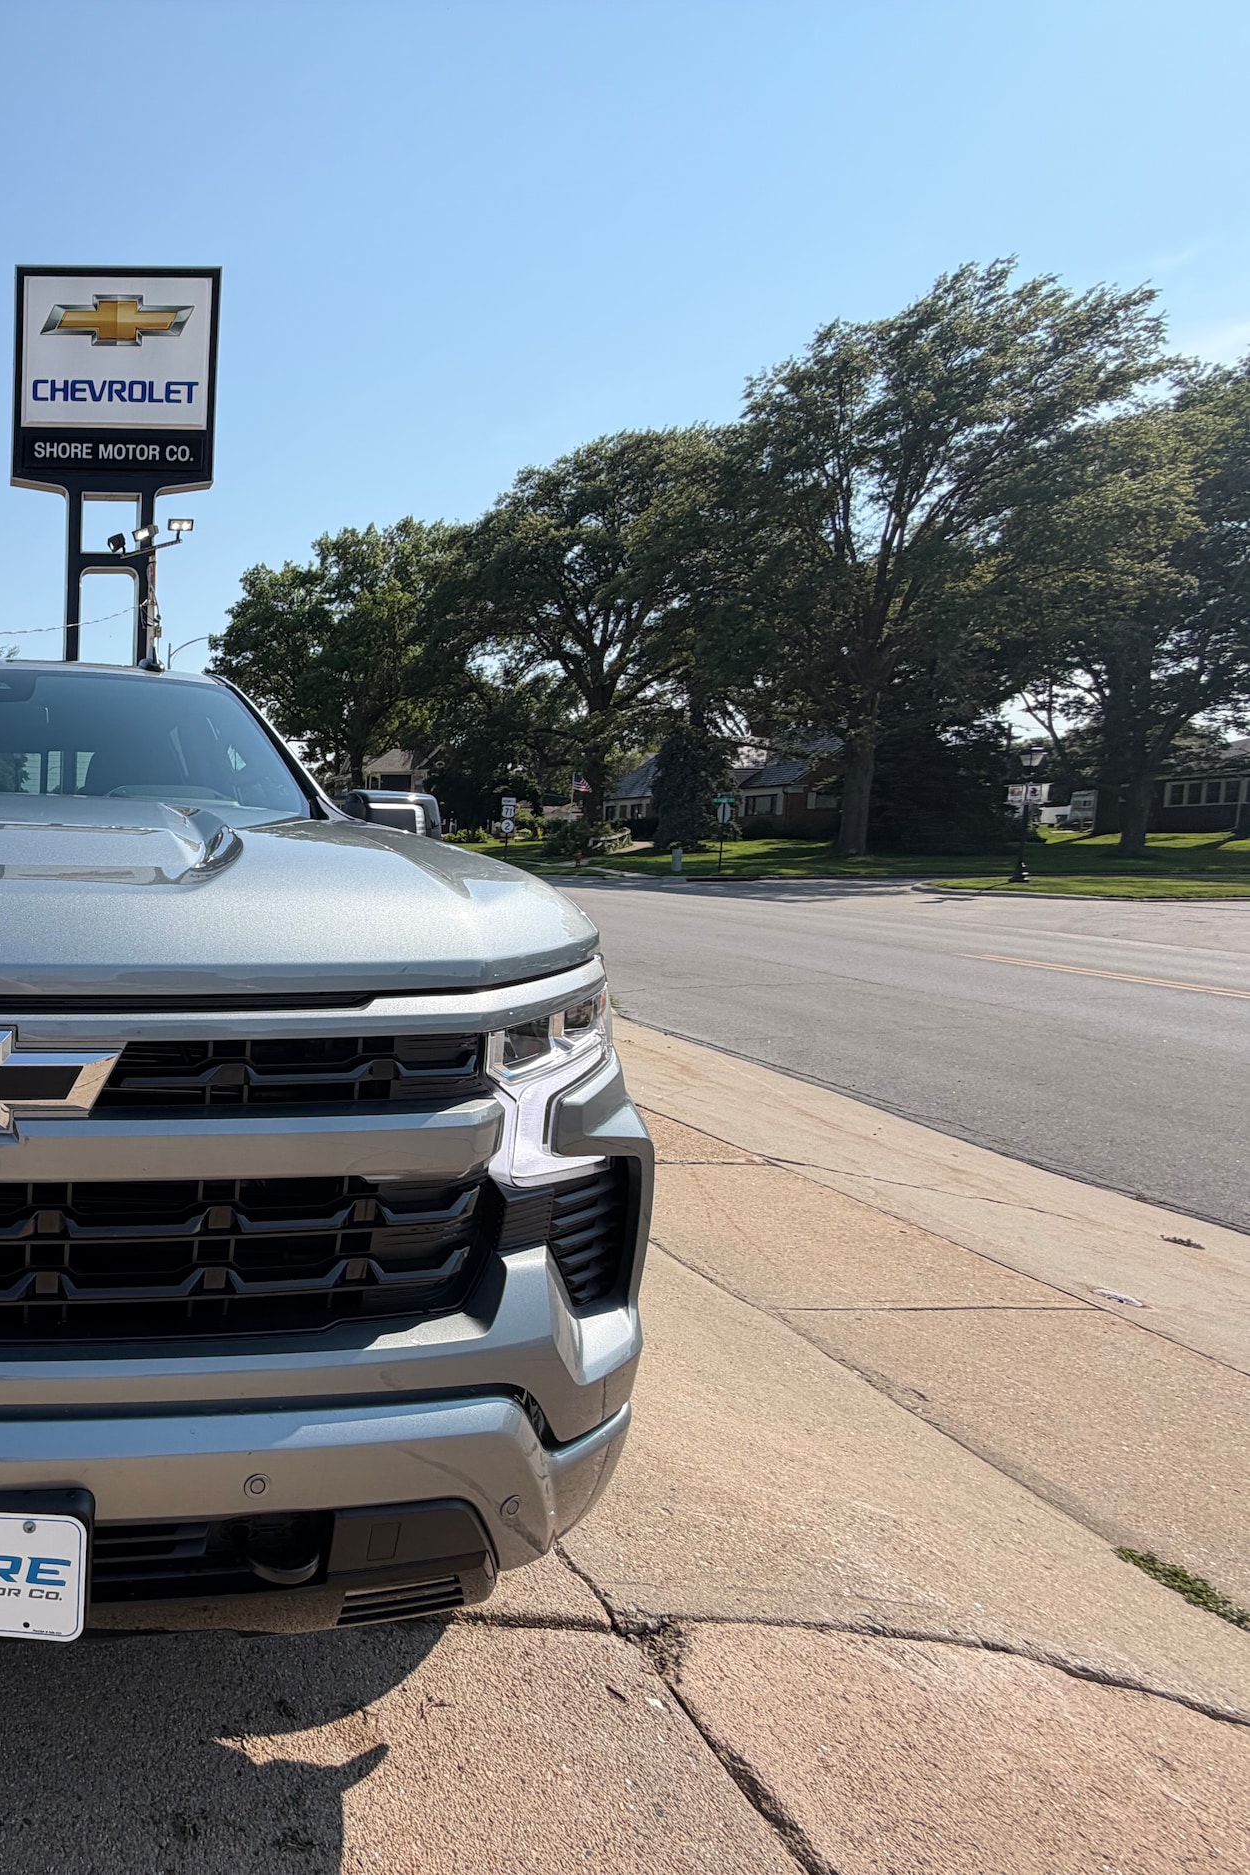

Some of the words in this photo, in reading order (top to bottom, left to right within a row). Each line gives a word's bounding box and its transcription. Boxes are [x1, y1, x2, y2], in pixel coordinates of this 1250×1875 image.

[32, 379, 199, 404] CHEVROLET
[34, 442, 93, 459] SHORE
[98, 444, 160, 461] MOTOR
[165, 446, 194, 462] CO.
